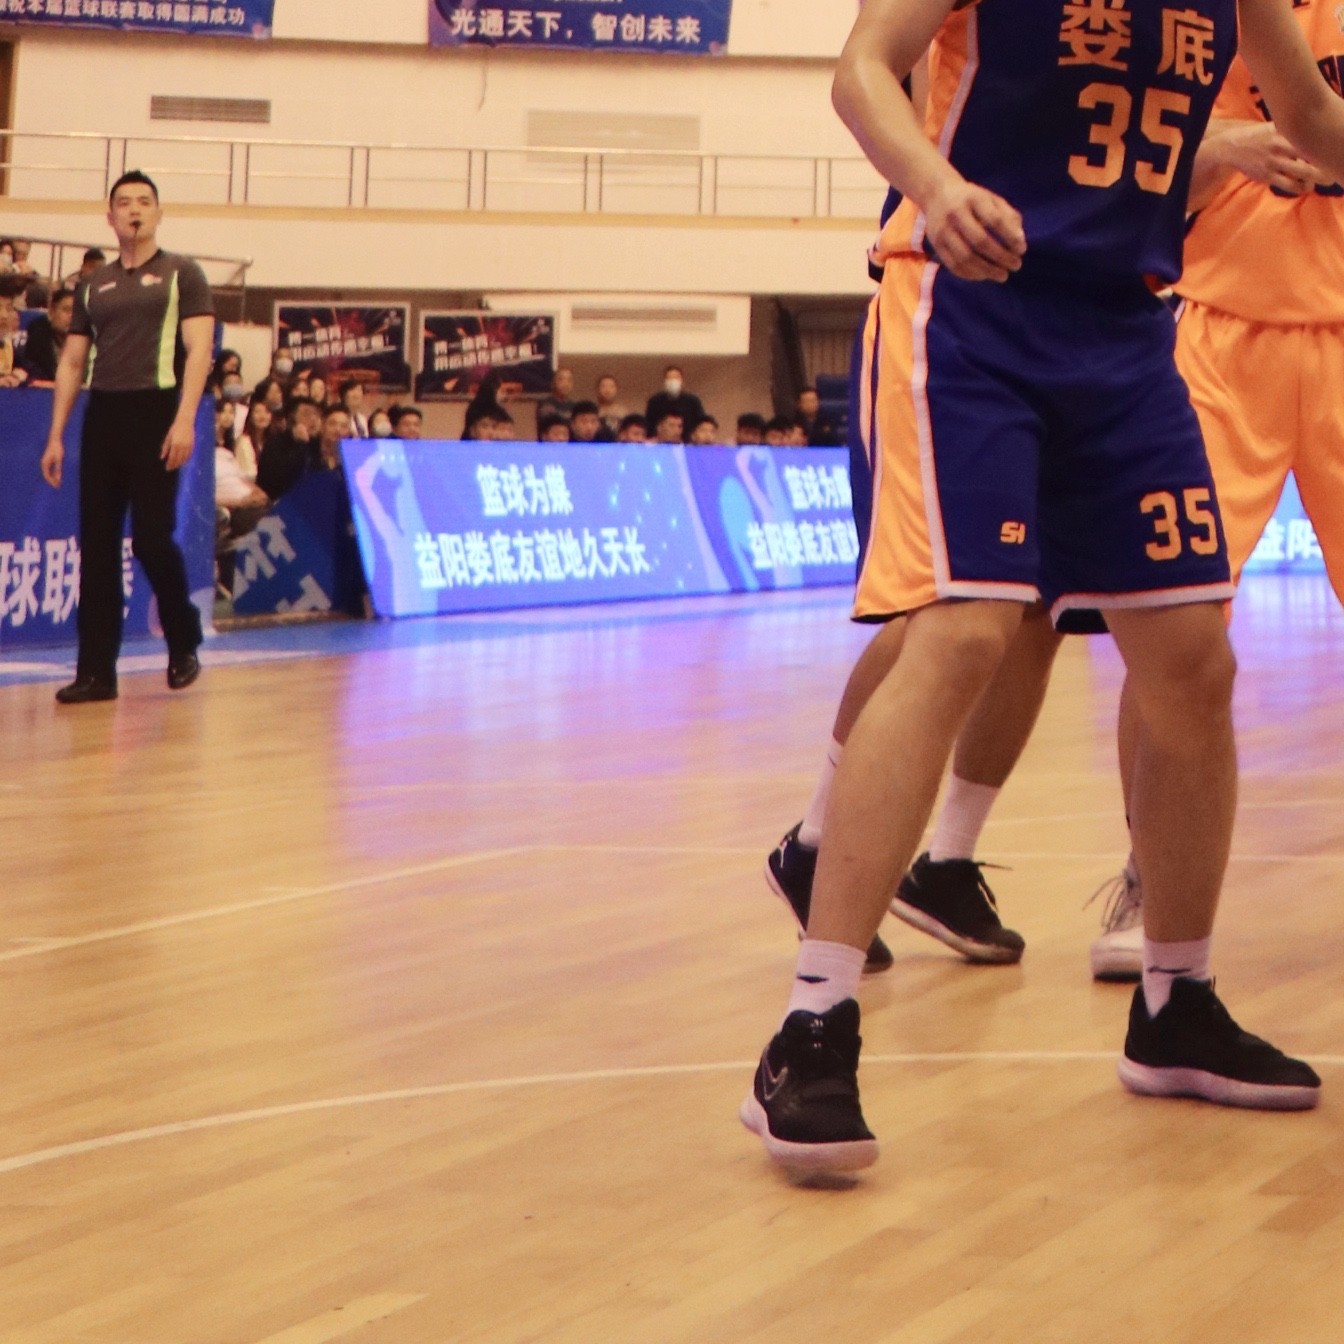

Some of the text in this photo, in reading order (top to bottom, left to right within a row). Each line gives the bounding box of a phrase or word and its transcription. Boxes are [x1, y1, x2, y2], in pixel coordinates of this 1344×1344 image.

[1068, 81, 1191, 195] 35
[476, 463, 574, 517] 篮球为媒
[1139, 487, 1218, 561] 35
[414, 526, 651, 589] 益阳娄底友谊地久天长
